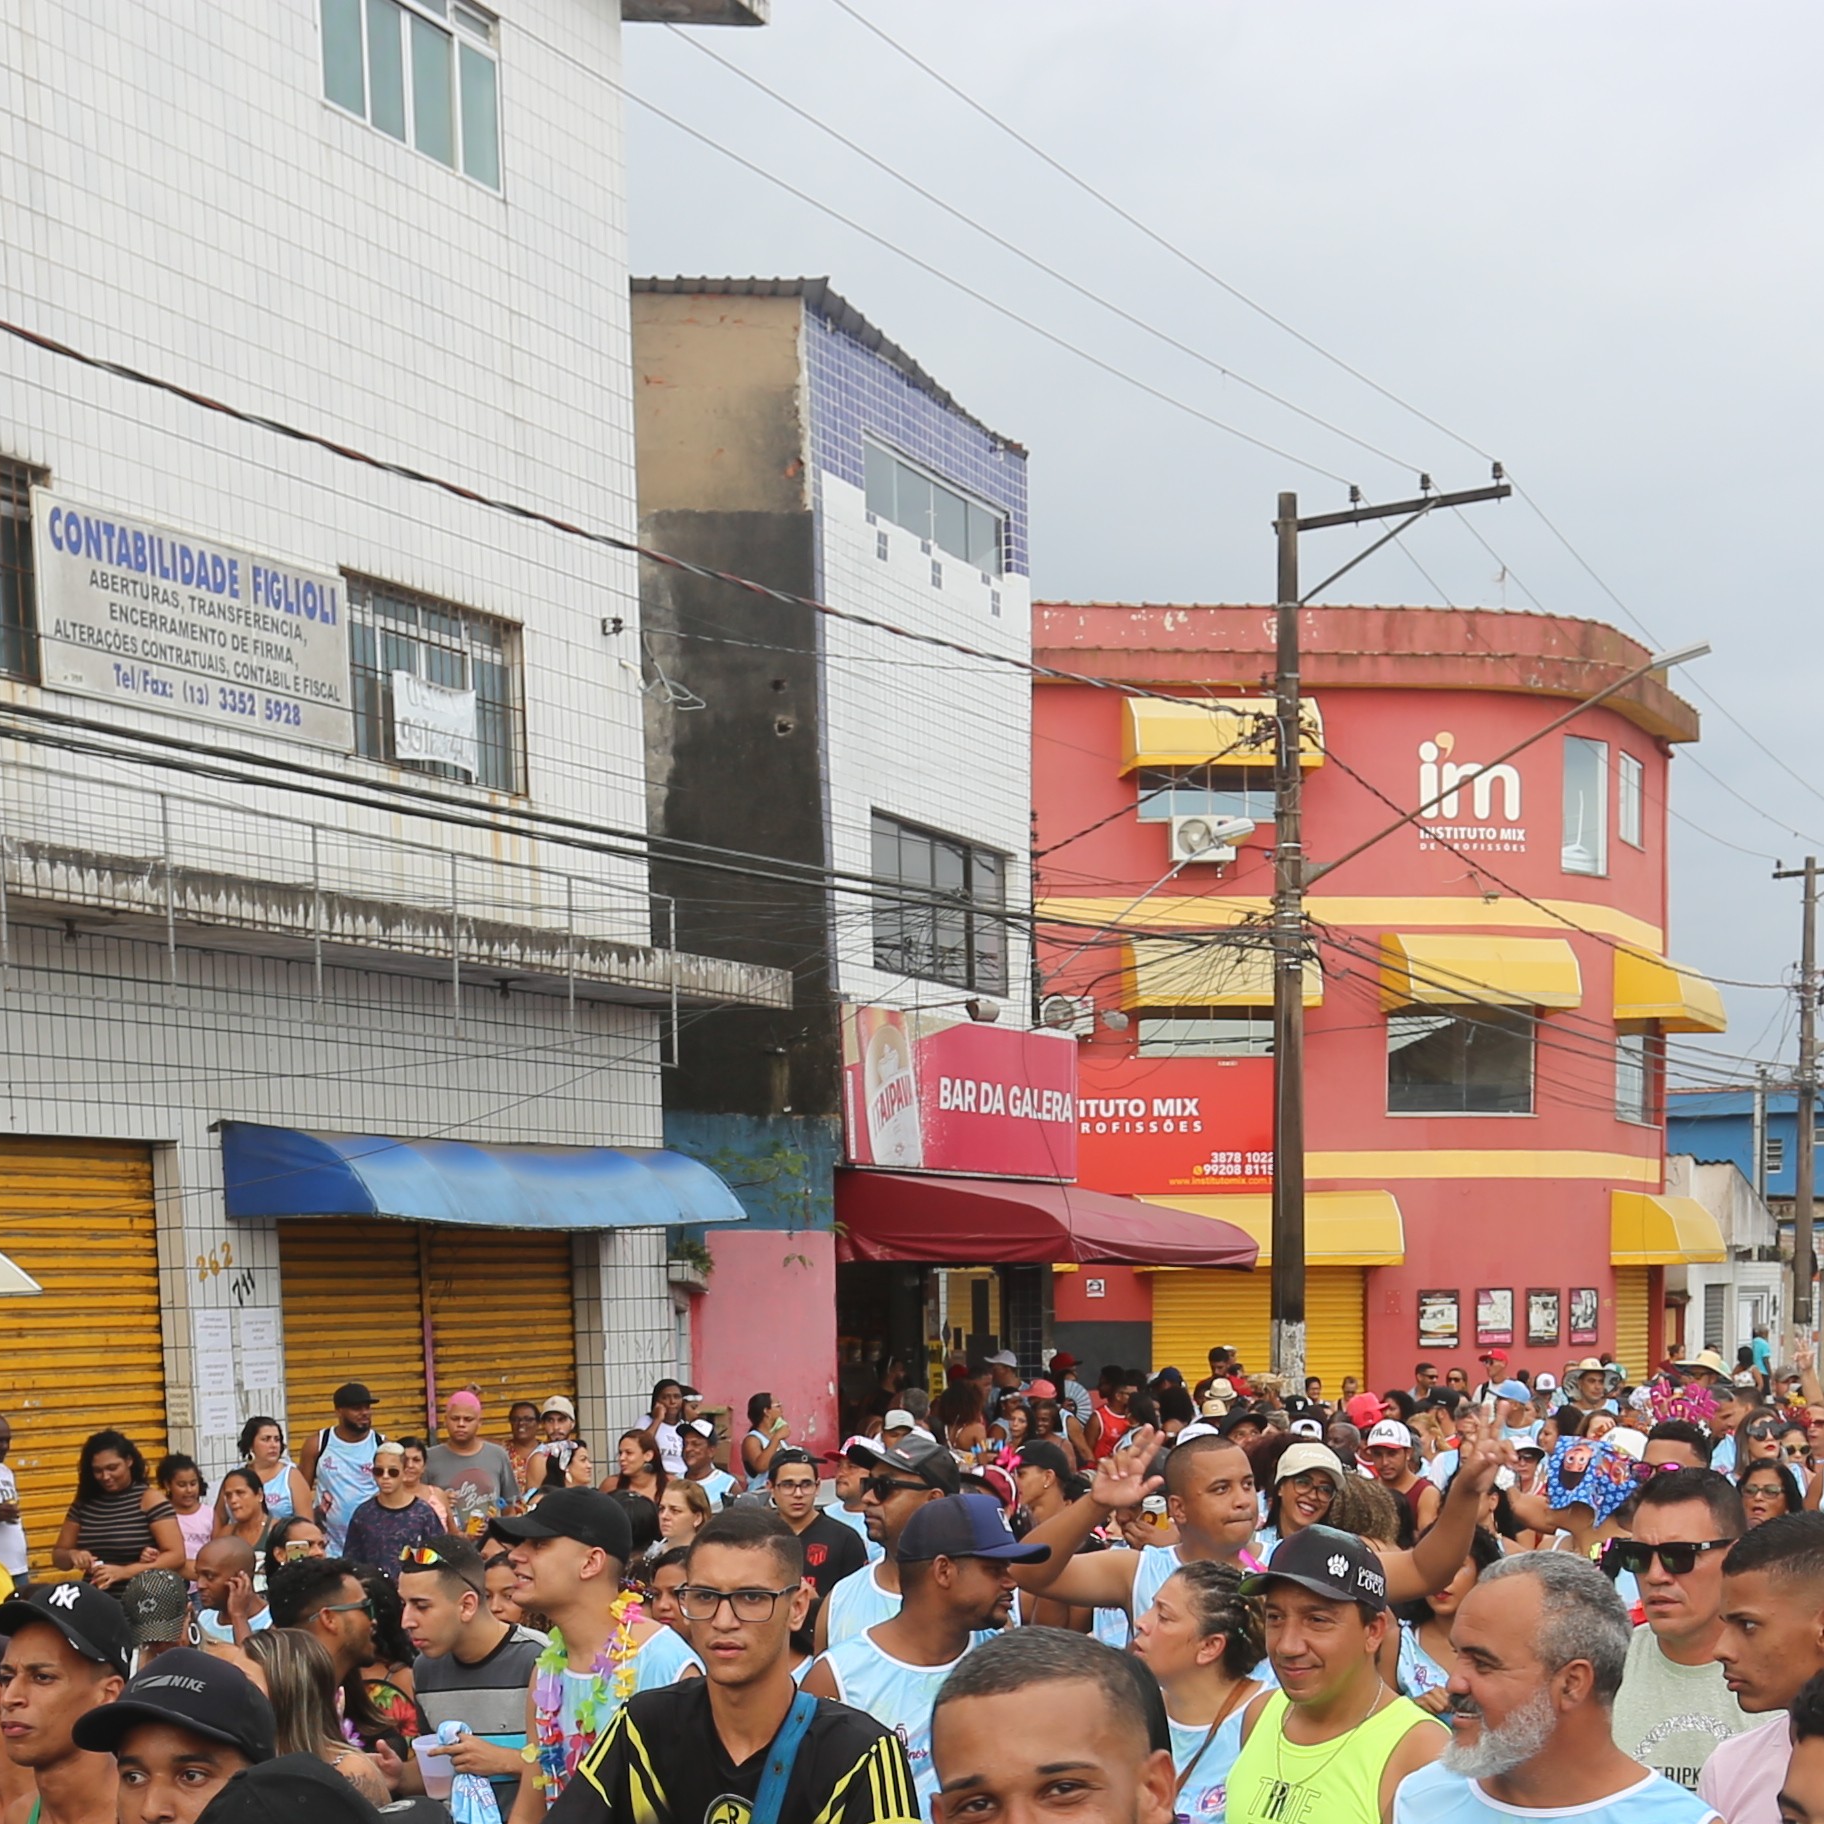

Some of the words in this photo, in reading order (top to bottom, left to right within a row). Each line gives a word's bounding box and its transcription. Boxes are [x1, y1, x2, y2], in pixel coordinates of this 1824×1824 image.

[48, 505, 239, 598] CONTABILIDADE
[252, 565, 337, 626] FIGLIOLI
[89, 569, 185, 613] ABERTURAS,
[109, 603, 227, 648] ENCERRAMENTO
[232, 634, 249, 653] DE
[54, 618, 139, 656] ALTERAÇÕES
[141, 639, 231, 680] CONTRATUAIS,
[294, 677, 302, 693] E
[303, 677, 341, 702] FISCAL
[114, 663, 174, 699] Tel/Fax:
[182, 682, 210, 706] (13)
[219, 688, 256, 717] 3352
[265, 699, 301, 727] 5928
[1419, 826, 1498, 840] INSTITUTO
[1499, 828, 1526, 842] MIX
[939, 1076, 977, 1113] BAR
[979, 1082, 1006, 1116] DA
[1009, 1085, 1074, 1123] GALERA
[1076, 1098, 1147, 1118] ITUTO
[1152, 1098, 1200, 1118] MIX
[1203, 1164, 1242, 1175] 99208
[1211, 1152, 1242, 1163] 3878
[170, 1674, 207, 1694] NIKE
